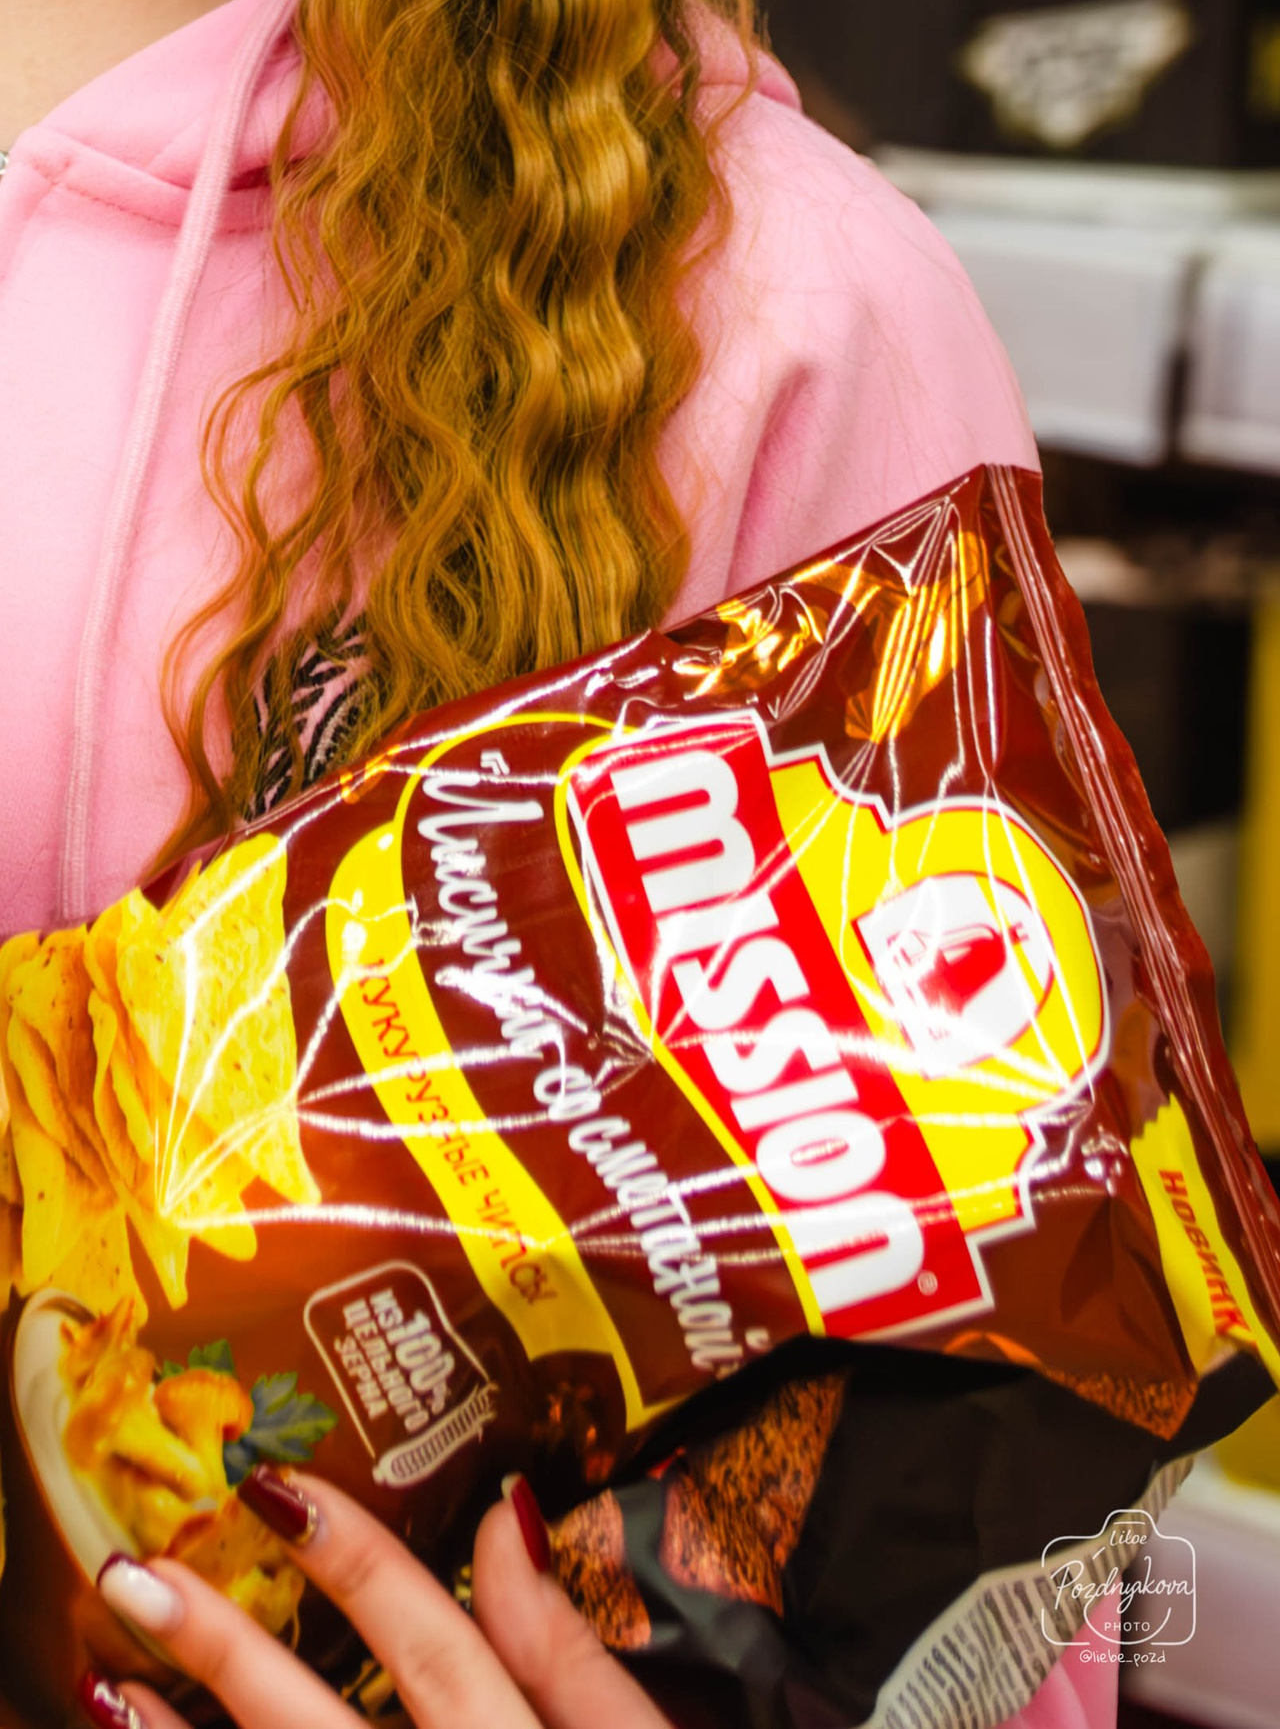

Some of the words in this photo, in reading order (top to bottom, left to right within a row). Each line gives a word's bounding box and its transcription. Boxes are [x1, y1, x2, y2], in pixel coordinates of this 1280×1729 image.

[532, 1065, 602, 1122] со
[1158, 1168, 1258, 1349] НОВИНК
[370, 1287, 404, 1329] ИЗ
[333, 1335, 389, 1419] ЗЕРНА
[342, 1298, 430, 1433] ЦЕЛЬНОГО
